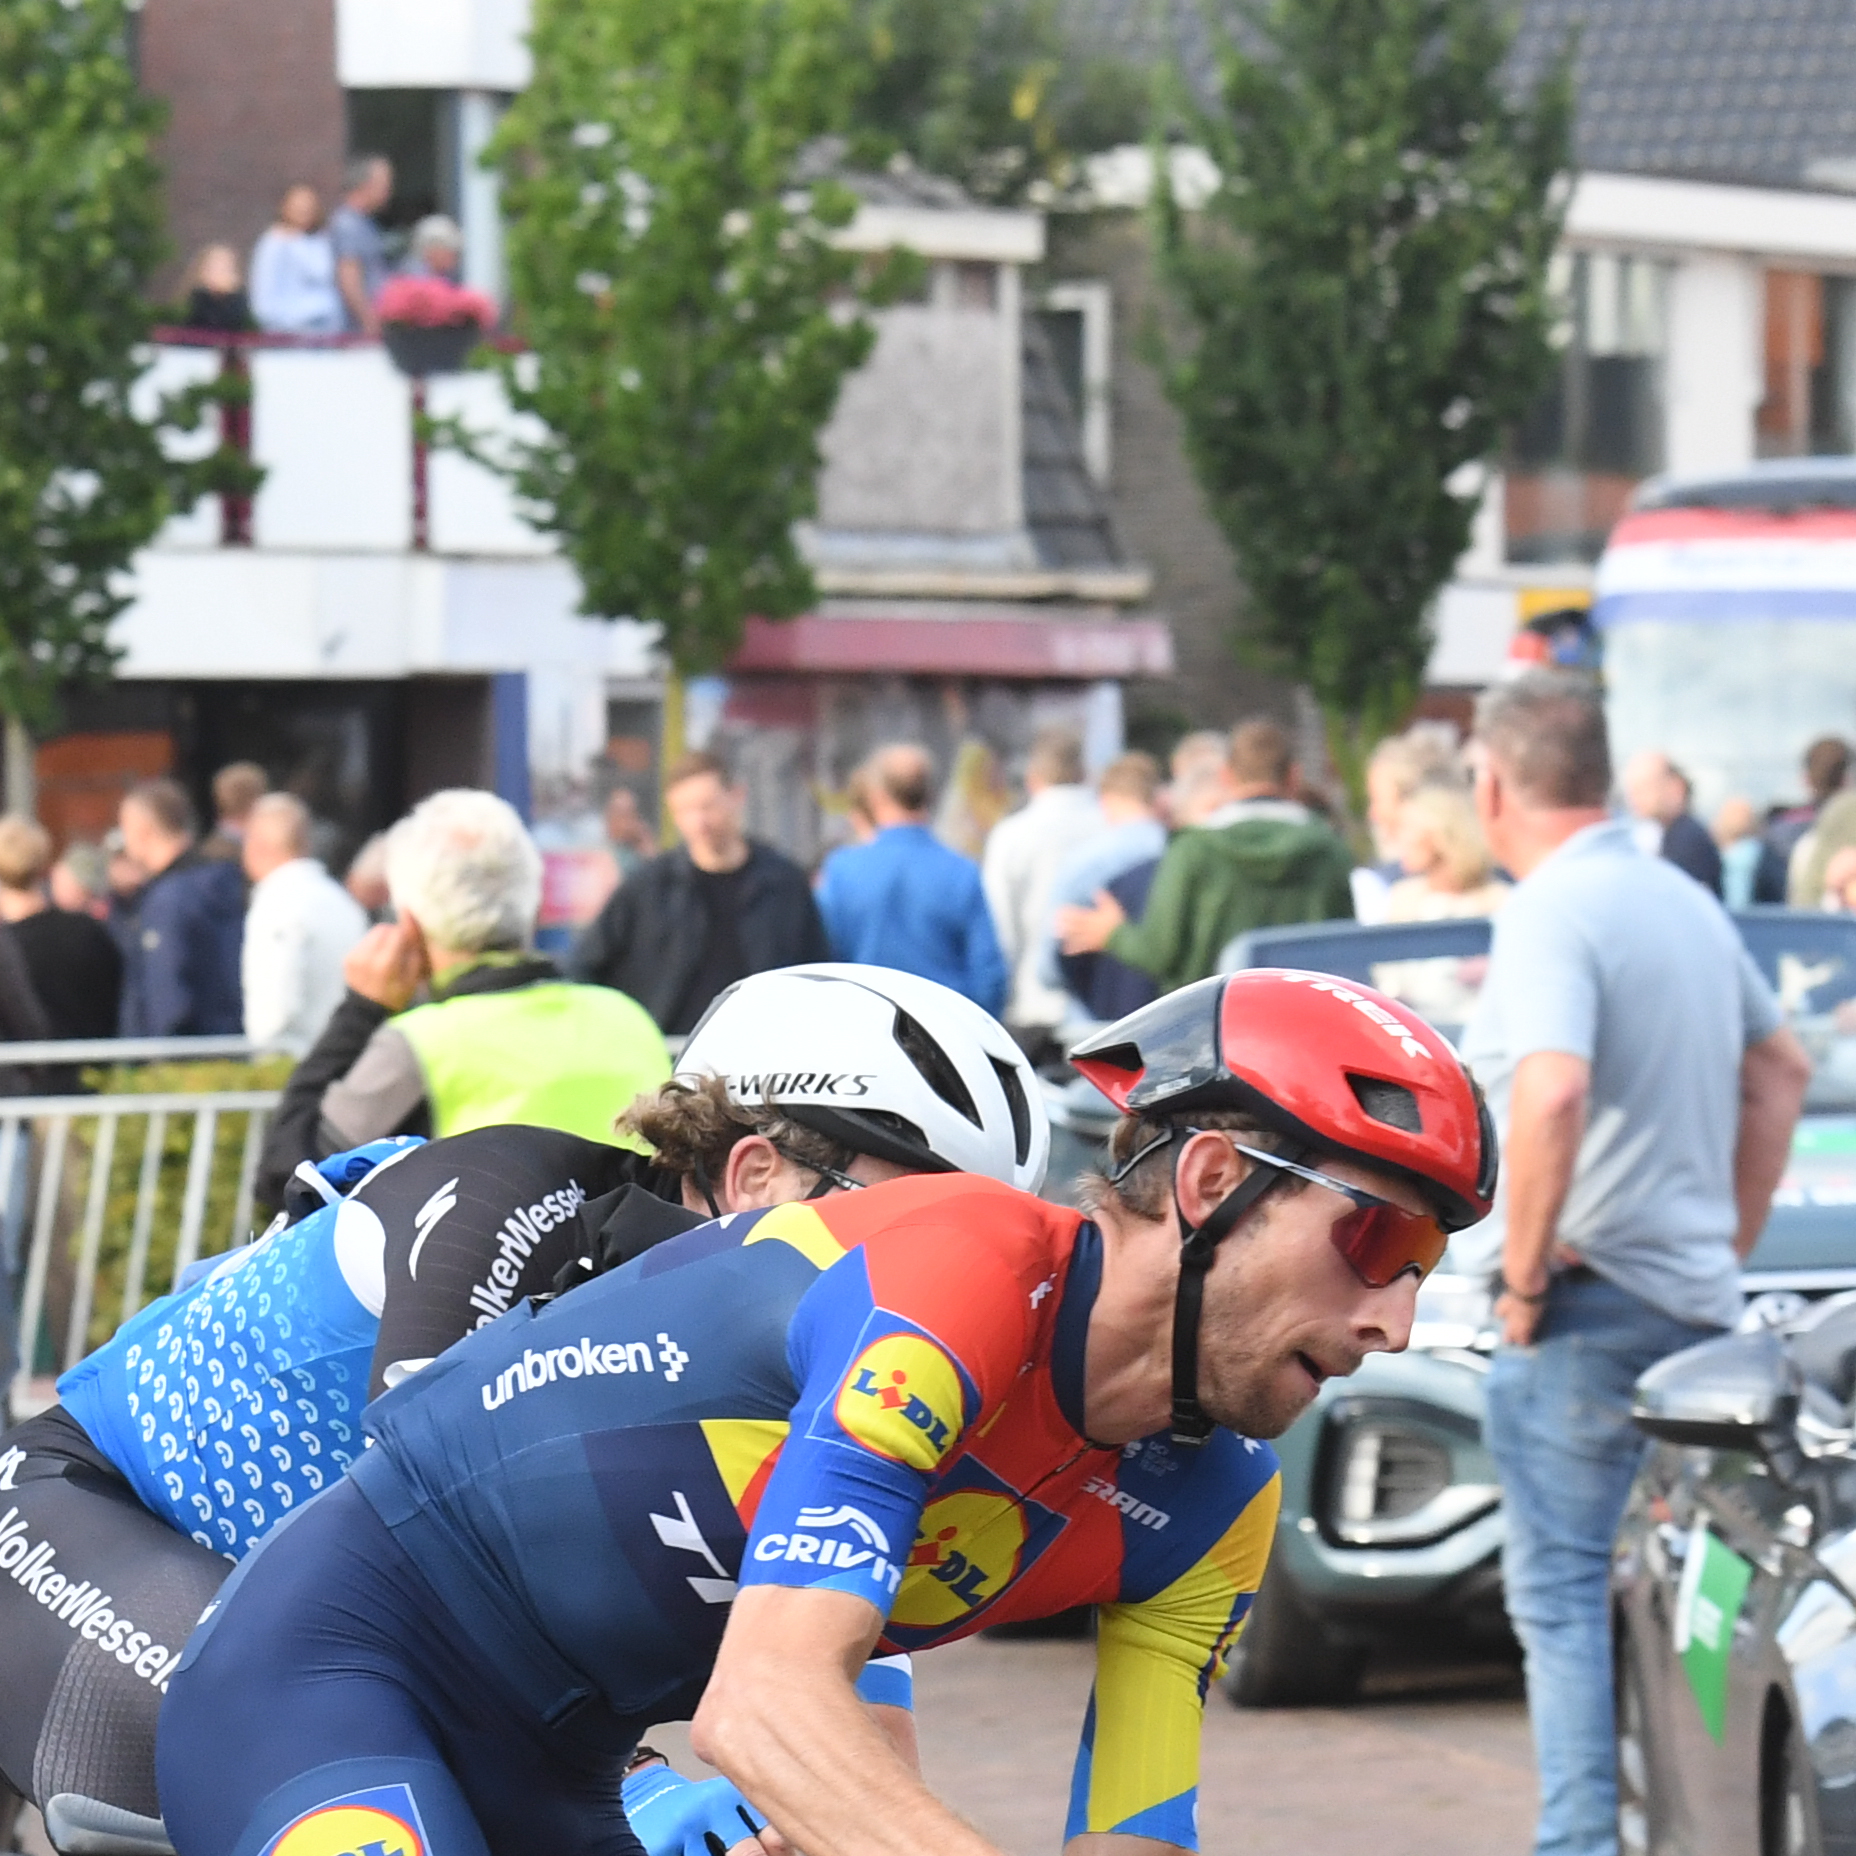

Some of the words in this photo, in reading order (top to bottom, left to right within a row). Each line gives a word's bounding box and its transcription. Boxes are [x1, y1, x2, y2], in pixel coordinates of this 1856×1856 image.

[1282, 972, 1433, 1060] TREK
[481, 1336, 655, 1412] unbroken
[1079, 1476, 1172, 1532] SRAM
[753, 1532, 903, 1595] CRIVIT
